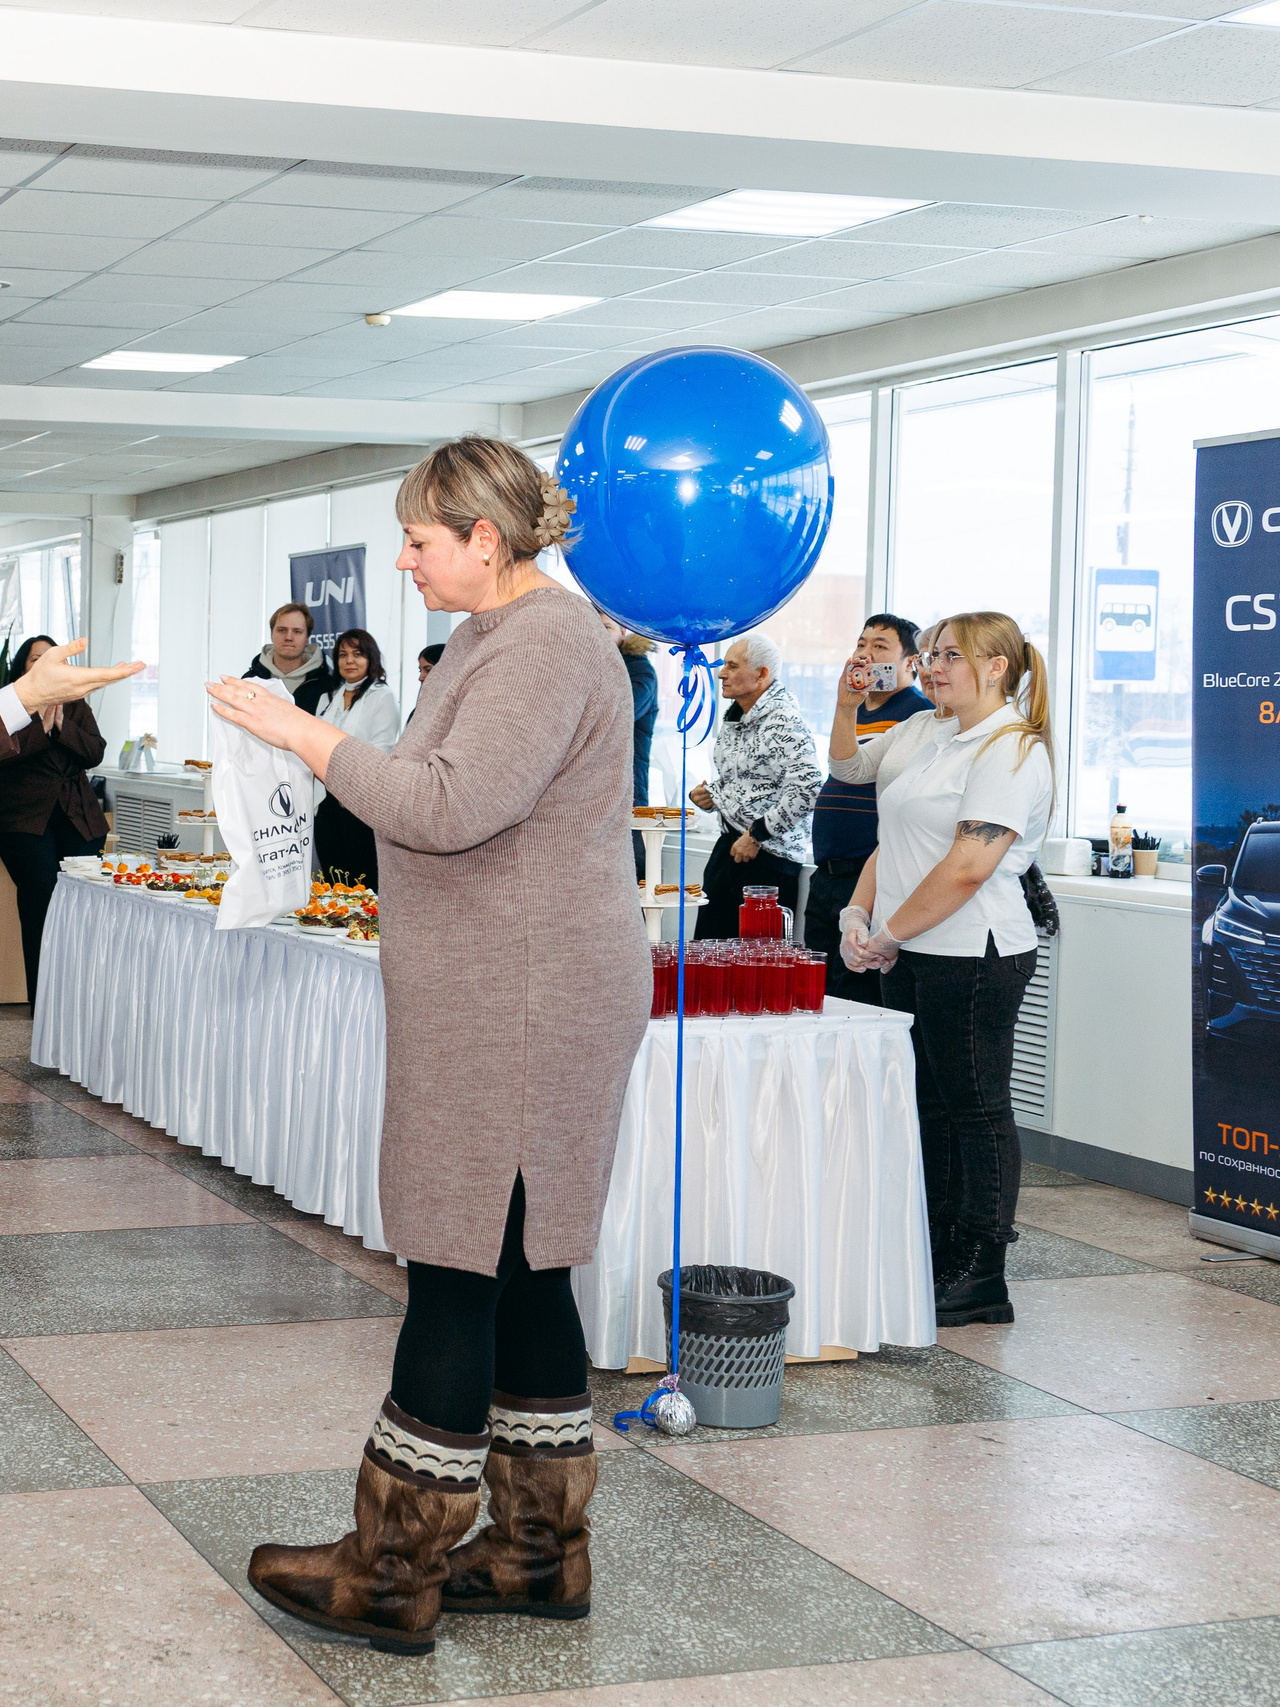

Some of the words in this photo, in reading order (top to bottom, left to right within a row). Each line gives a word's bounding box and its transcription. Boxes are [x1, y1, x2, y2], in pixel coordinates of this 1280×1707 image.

[305, 576, 355, 607] UNI
[1225, 593, 1280, 632] CS
[1203, 672, 1270, 688] BlueCore
[1218, 1122, 1280, 1156] ТОП-
[1200, 1151, 1216, 1162] по
